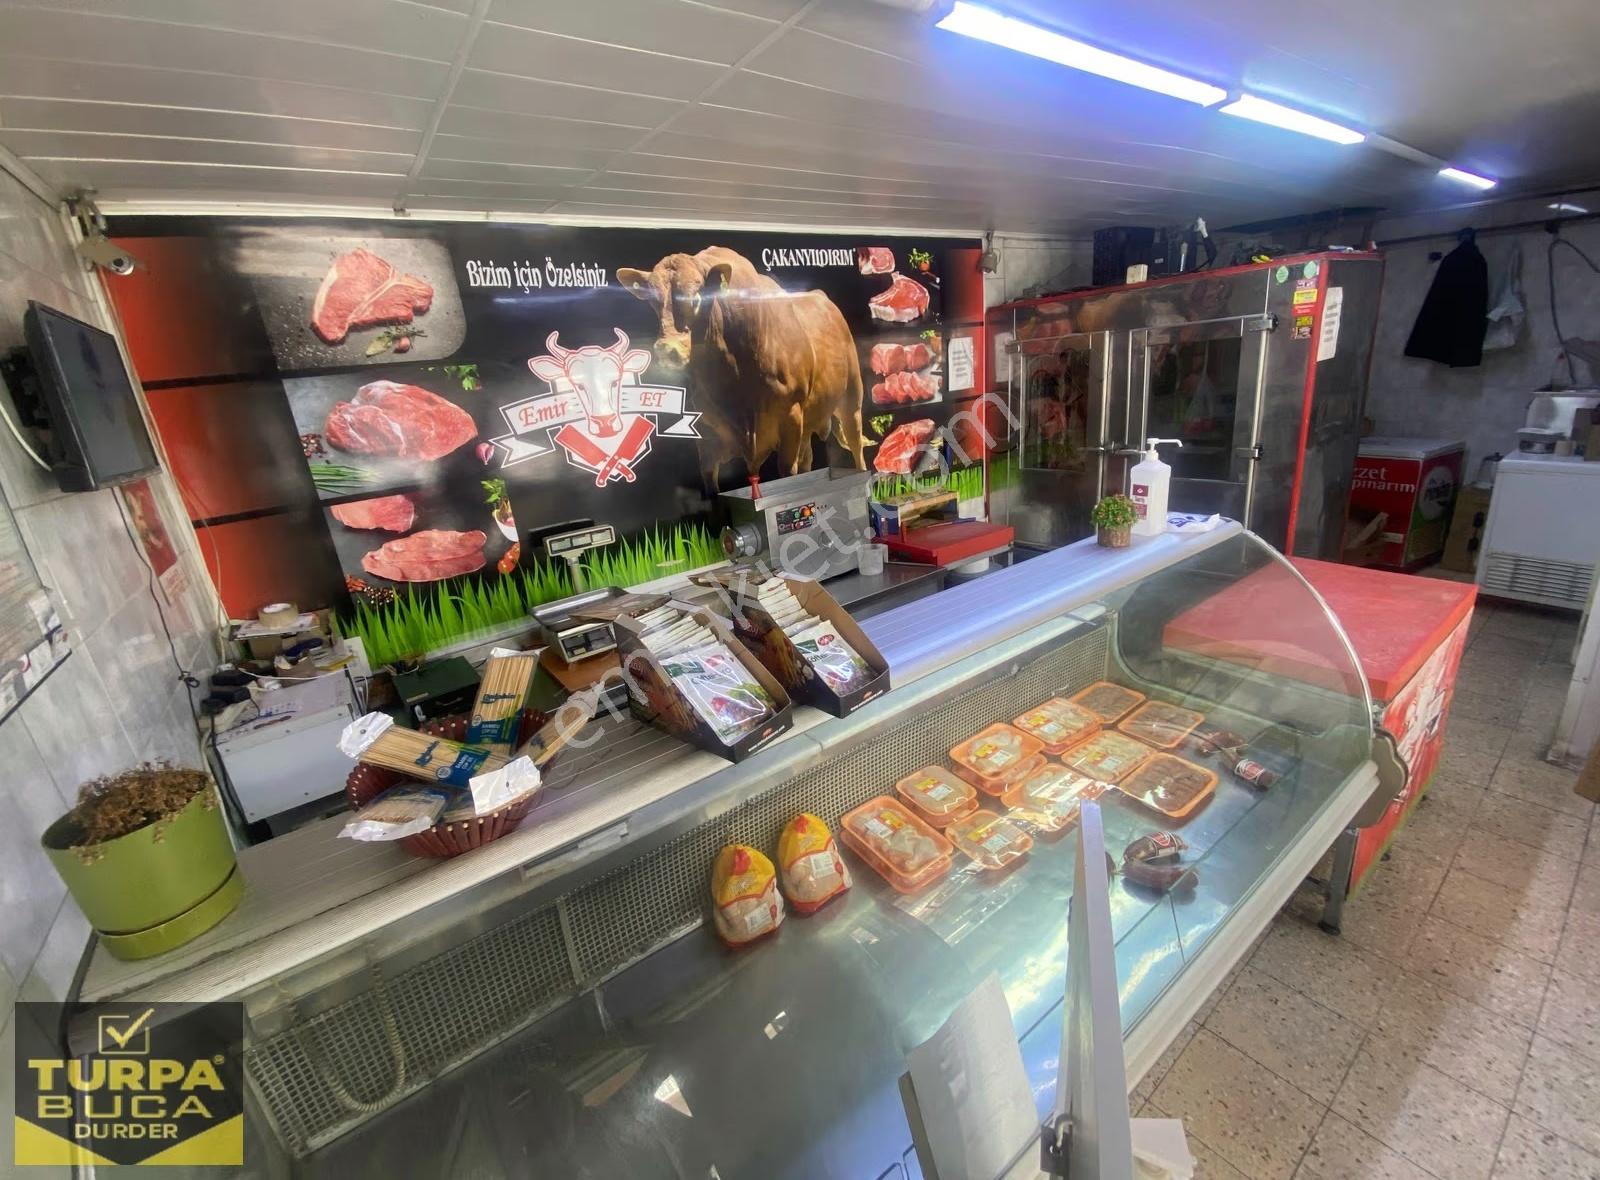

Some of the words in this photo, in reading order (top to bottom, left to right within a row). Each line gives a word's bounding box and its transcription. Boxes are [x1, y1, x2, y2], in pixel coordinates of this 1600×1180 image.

[466, 260, 511, 288] Bizim
[514, 260, 542, 293] için
[546, 256, 608, 287] Özelsiniz
[518, 399, 569, 427] Emir
[640, 391, 667, 408] ET
